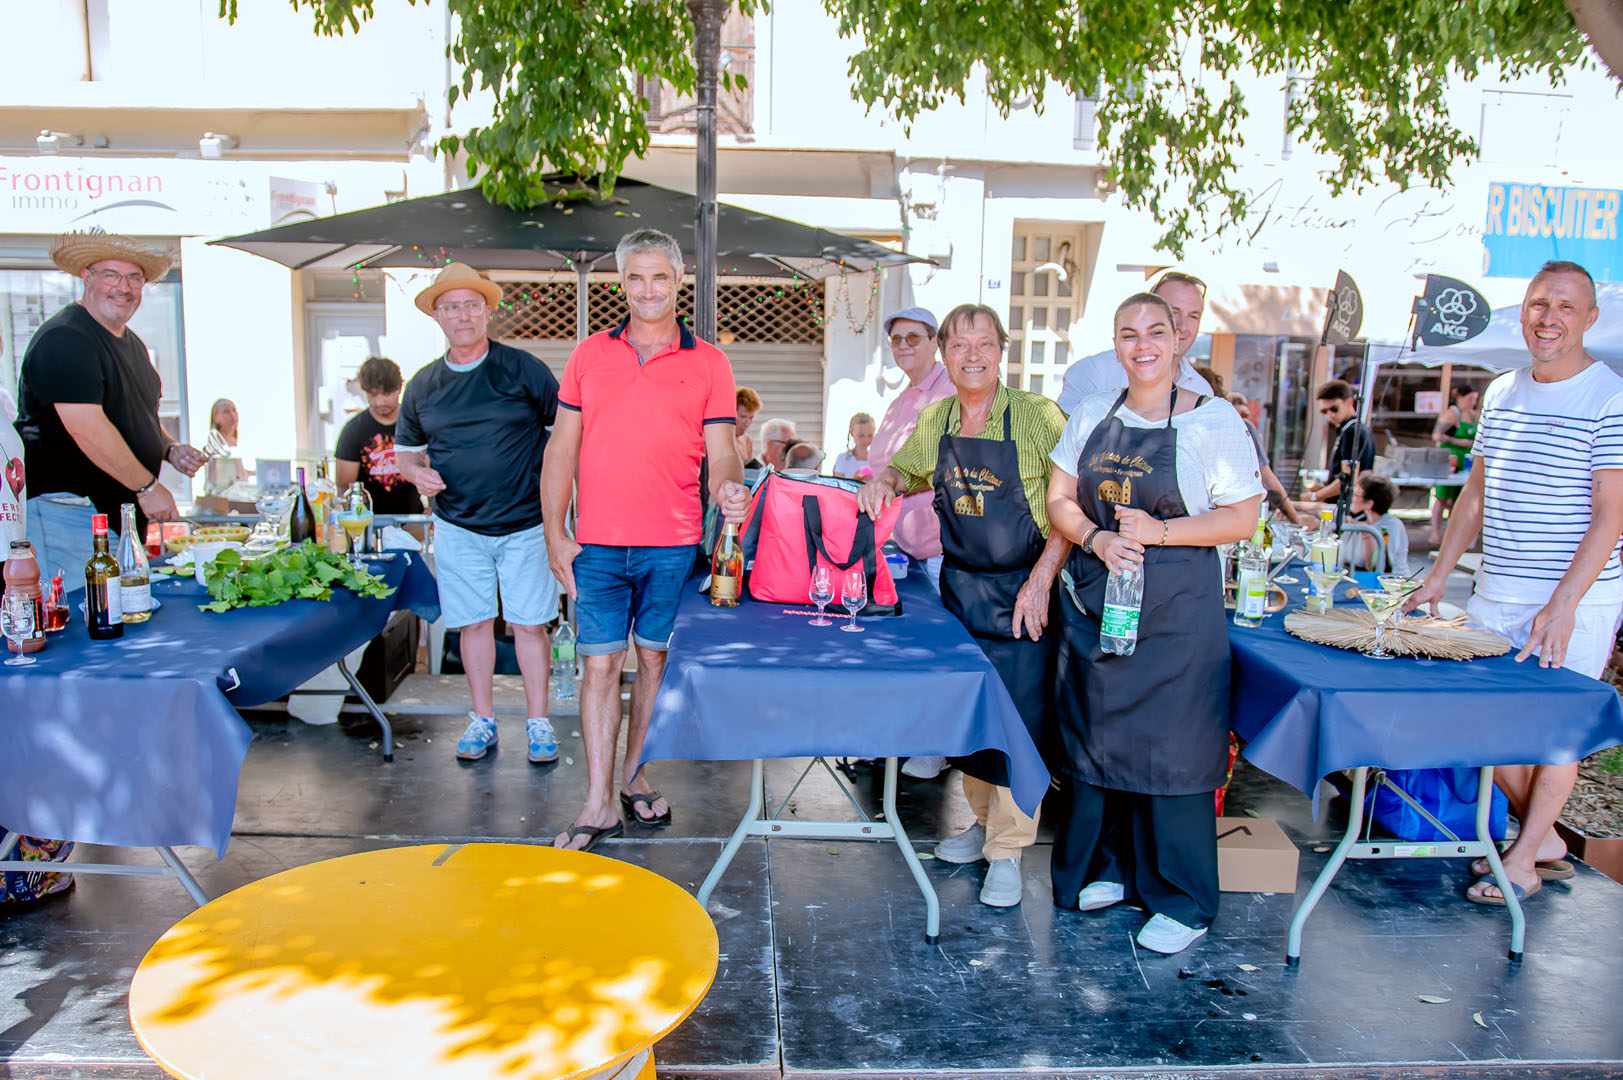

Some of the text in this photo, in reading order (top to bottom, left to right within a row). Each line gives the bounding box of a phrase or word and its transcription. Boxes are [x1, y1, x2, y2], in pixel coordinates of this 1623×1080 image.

[1507, 186, 1620, 240] BISCUITIER
[1332, 320, 1351, 338] AKG
[1430, 322, 1469, 337] AKG
